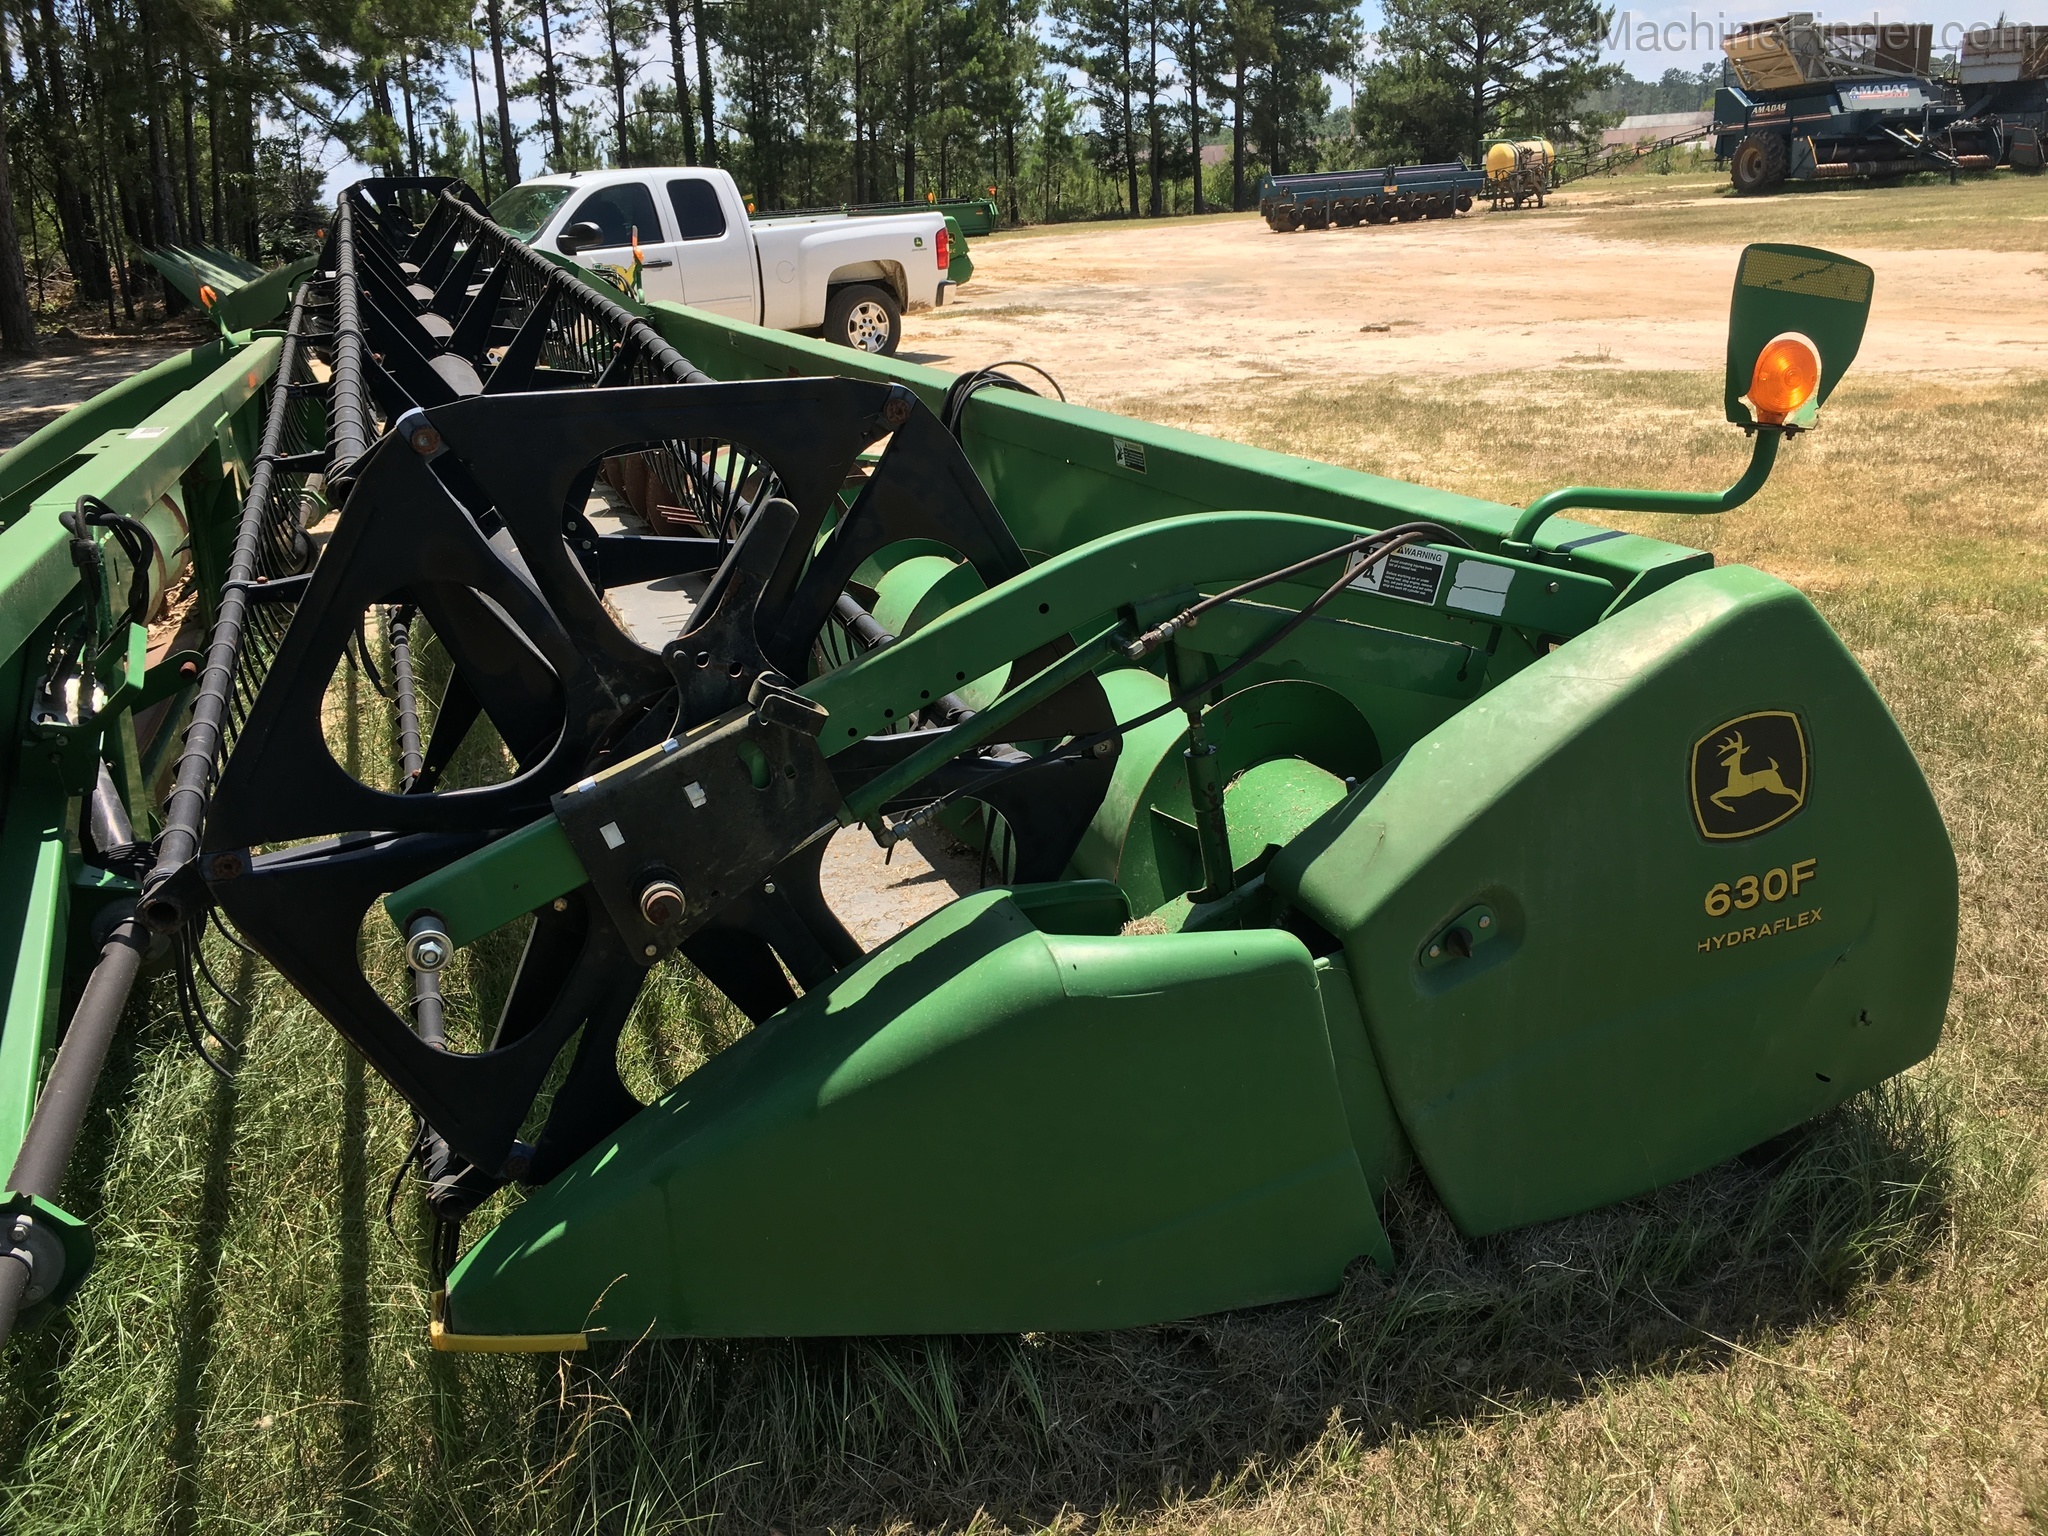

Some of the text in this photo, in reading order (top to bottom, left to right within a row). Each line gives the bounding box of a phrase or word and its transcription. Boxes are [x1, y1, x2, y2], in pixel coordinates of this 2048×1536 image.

[1849, 83, 1909, 96] AMADAS
[1751, 102, 1787, 114] AMADAS
[1403, 548, 1442, 562] WARNING
[1704, 857, 1817, 917] 630F
[1697, 907, 1823, 953] HYDRAFLEX
